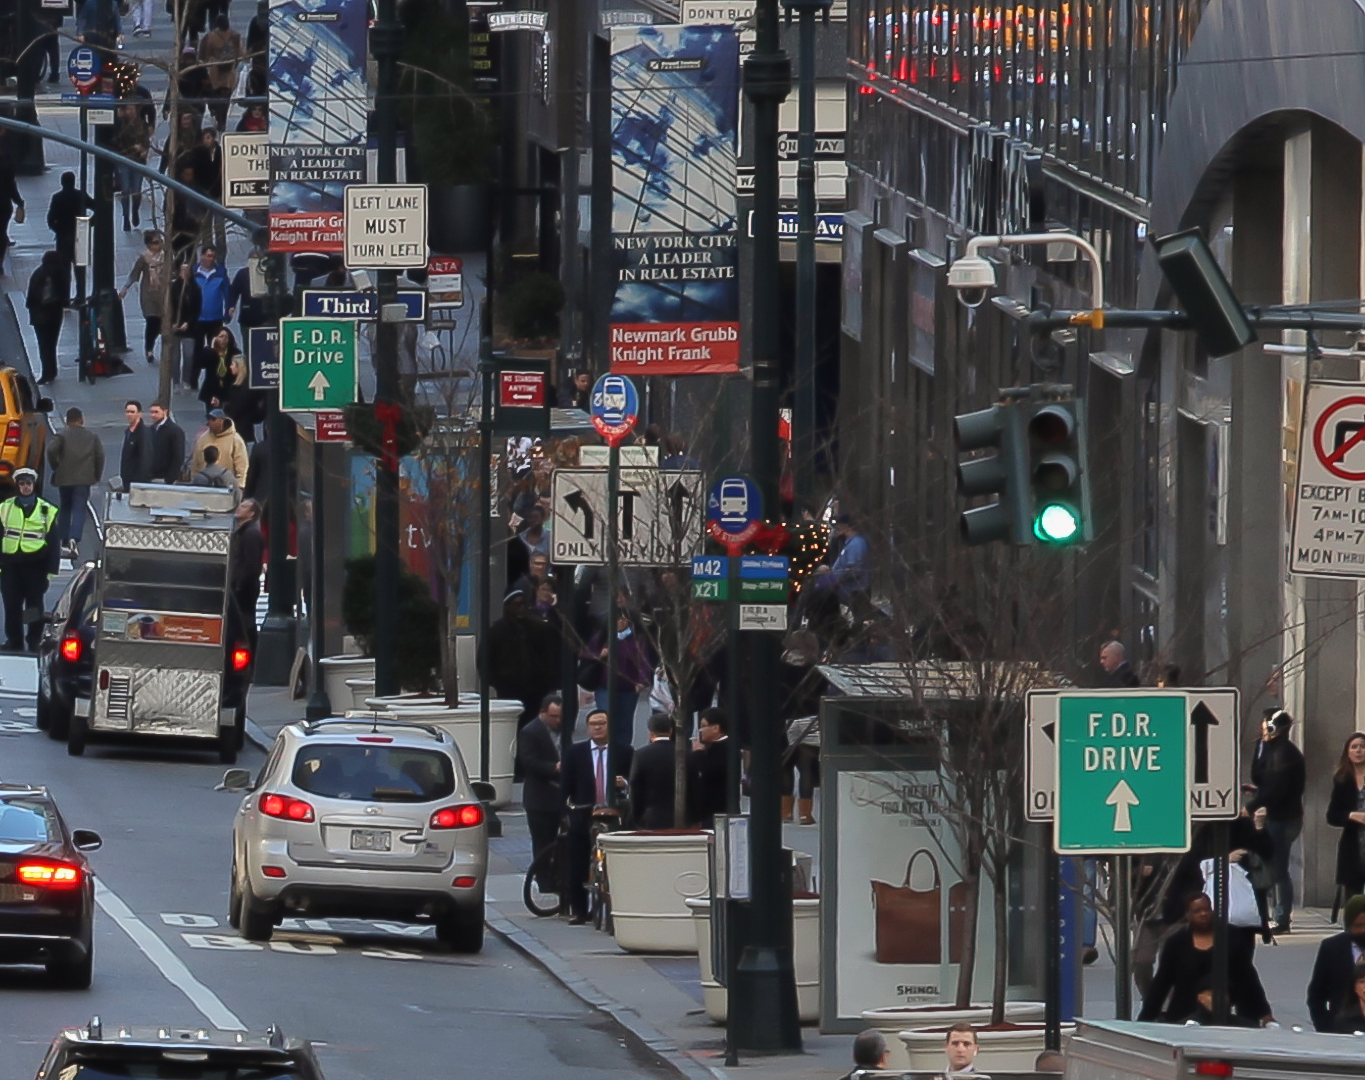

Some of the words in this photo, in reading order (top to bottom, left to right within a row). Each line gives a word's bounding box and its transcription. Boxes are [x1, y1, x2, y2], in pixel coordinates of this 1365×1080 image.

[688, 8, 725, 20] DON'T
[728, 9, 756, 20] BLO
[271, 146, 296, 156] NEW
[778, 139, 797, 152] ON
[290, 159, 298, 169] A
[301, 159, 346, 169] LEADER
[275, 170, 287, 180] IN
[290, 170, 320, 180] REAL
[322, 170, 362, 180] ESTATE
[233, 183, 257, 194] FINE
[353, 197, 381, 210] LEFT
[388, 196, 419, 209] LANE
[271, 216, 326, 228] Newmark
[365, 218, 407, 234] MUST
[271, 231, 309, 245] Knight
[614, 236, 650, 250] NEW
[653, 236, 695, 249] YORK
[352, 244, 385, 257] TURN
[390, 244, 422, 257] LEFT
[639, 254, 649, 266] A
[654, 252, 712, 265] LEADER
[619, 268, 636, 281] IN
[640, 267, 679, 281] REAL
[682, 265, 735, 280] ESTATE
[317, 297, 370, 314] Third
[612, 327, 686, 344] Newmark
[689, 326, 738, 342] Grubb
[293, 347, 344, 365] Drive
[612, 346, 665, 365] Knight
[668, 346, 712, 360] Frank
[1300, 484, 1351, 503] EXCEPT
[1313, 528, 1365, 545] 4PM-7
[556, 541, 601, 559] ONLY
[616, 541, 649, 559] NLY
[1297, 548, 1333, 564] MON
[1336, 549, 1365, 563] THRU
[693, 559, 722, 576] M42
[1082, 745, 1162, 772] DRIVE
[1190, 788, 1233, 809] NLY
[896, 984, 939, 997] SHINOL
